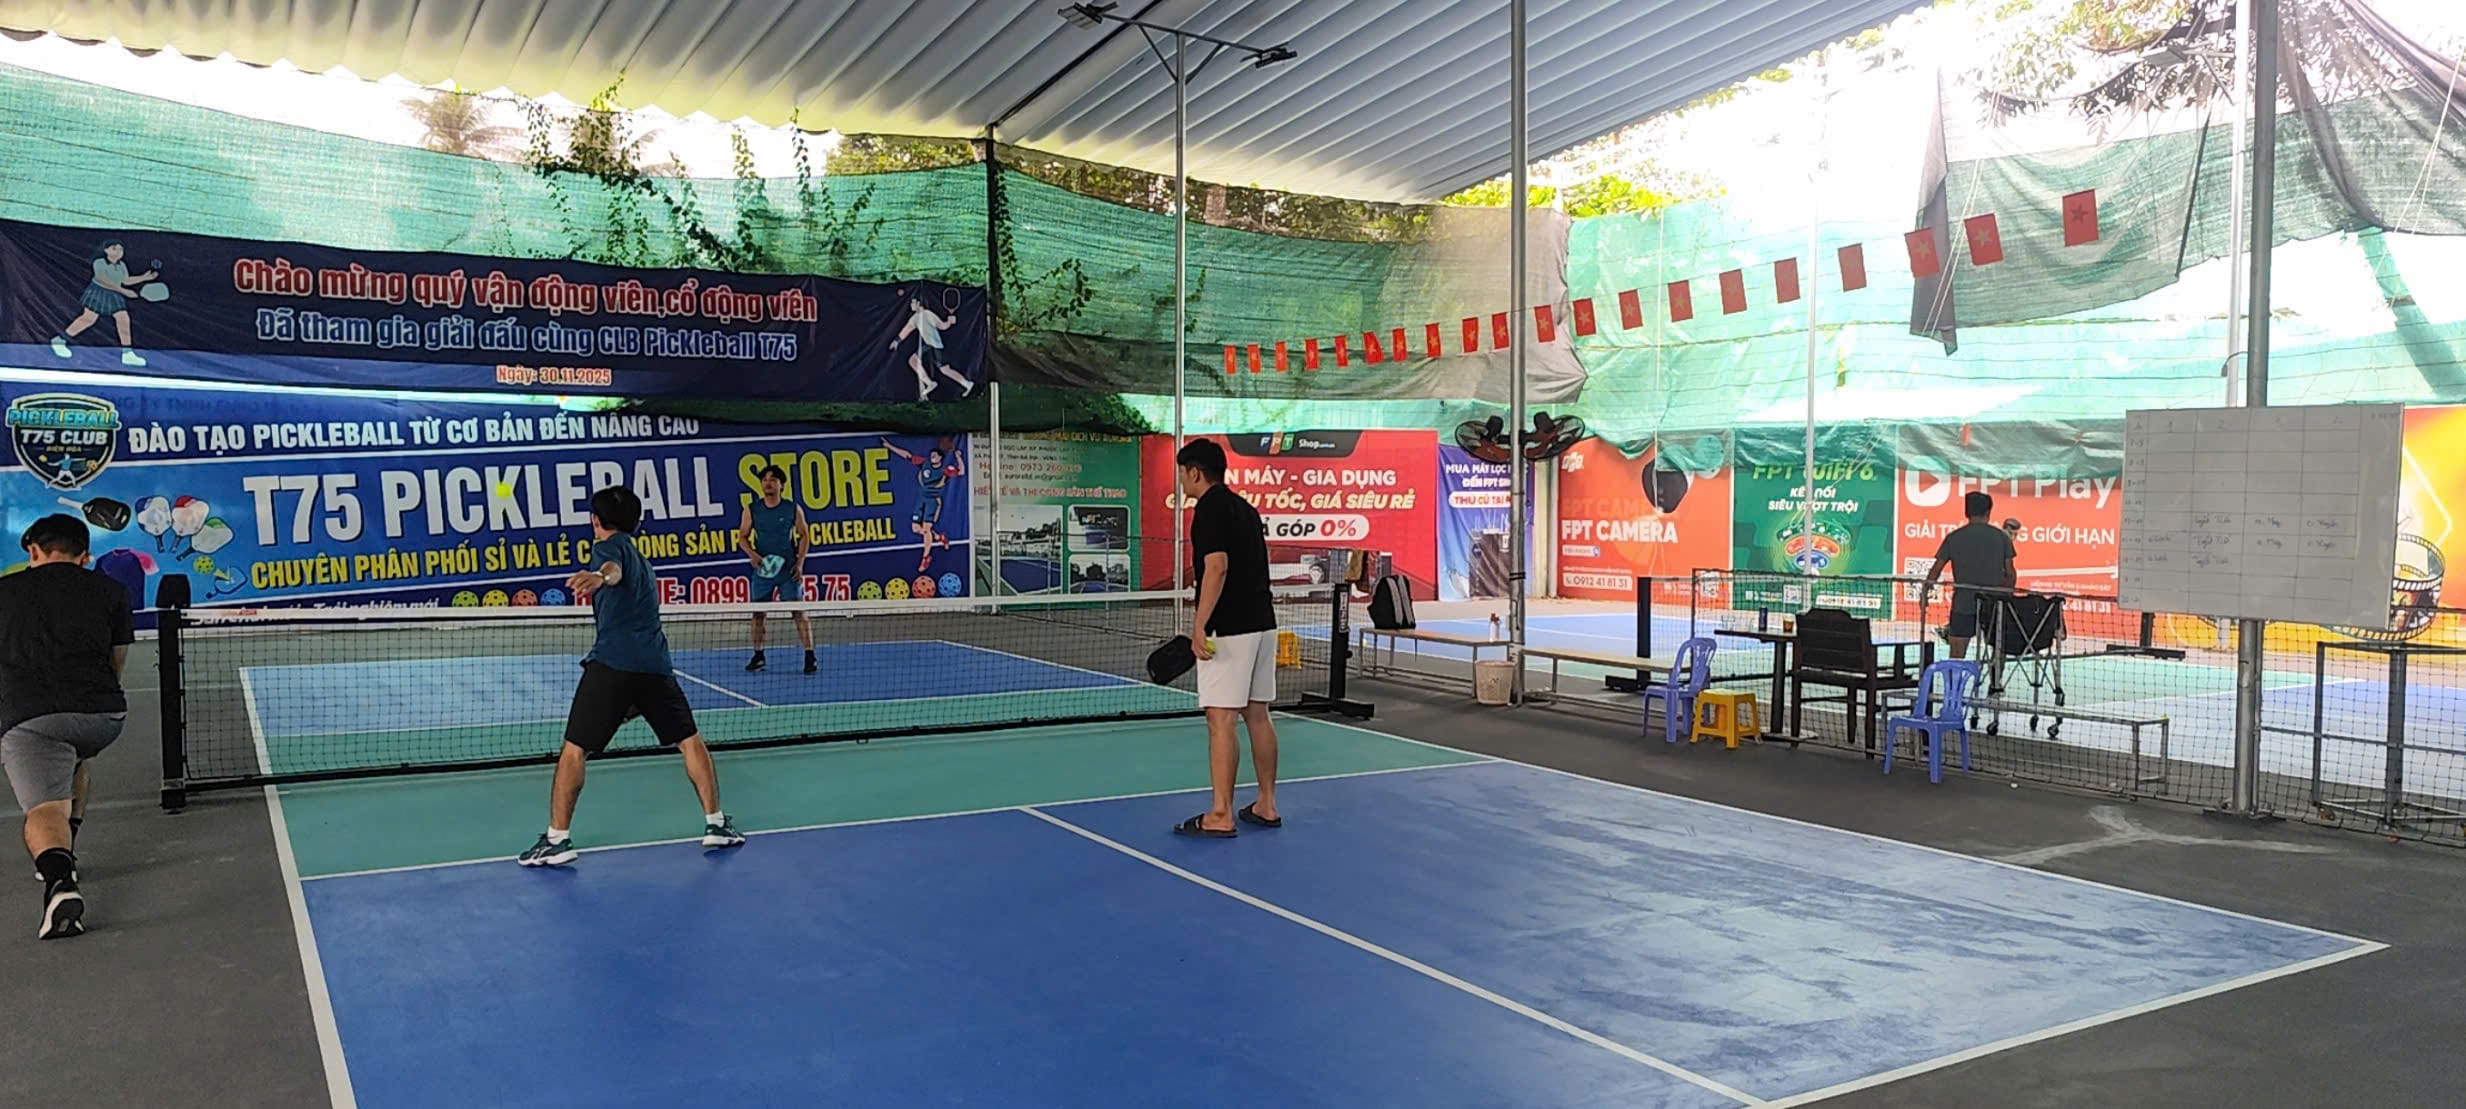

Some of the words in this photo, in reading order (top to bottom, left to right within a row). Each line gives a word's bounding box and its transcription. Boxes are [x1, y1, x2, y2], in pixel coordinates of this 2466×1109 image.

[234, 258, 313, 296] Chào
[319, 263, 407, 305] mừng
[412, 268, 466, 310] quý
[472, 270, 524, 313] vận
[528, 273, 598, 317] động
[701, 285, 763, 324] động
[767, 288, 818, 322] viên
[256, 308, 295, 340] Đã
[299, 311, 372, 344] tham
[377, 315, 420, 349] gia
[424, 315, 475, 350] giải
[478, 315, 528, 351] đấu
[531, 320, 594, 357] cùng
[598, 326, 641, 354] CLB
[644, 327, 756, 360] Pickleball
[759, 333, 798, 361] T75
[496, 364, 538, 385] Ngày:
[539, 367, 612, 386] 30.11.2025
[8, 408, 120, 428] PICKLEBALL
[20, 429, 55, 444] T75
[60, 430, 109, 445] CLUB
[128, 421, 187, 454] ĐÀO
[193, 425, 245, 456] TẠO
[254, 419, 404, 449] PICKLEBALL
[409, 416, 442, 444] TỪ
[446, 417, 478, 443] CƠ
[485, 410, 533, 443] BẢN
[538, 411, 586, 440] ĐẾN
[592, 414, 651, 438] NÂNG
[1261, 434, 1294, 451] FPT
[1244, 465, 1287, 486] MÁY
[1303, 469, 1337, 486] GIA
[1341, 469, 1397, 490] DỤNG
[1445, 464, 1470, 474] MUA
[1752, 464, 1793, 480] FPT
[243, 472, 363, 546] T75
[738, 448, 894, 511] STORE
[1958, 466, 2022, 498] FPT
[2035, 464, 2117, 509] Play
[1264, 487, 1307, 511] TỐC,
[1310, 489, 1343, 509] GIÁ
[1345, 490, 1389, 509] SIÊU
[1389, 488, 1416, 509] RẺ
[1455, 496, 1477, 505] THU
[1768, 498, 1795, 510] SIÊU
[1831, 499, 1859, 514] TRỘI
[1276, 518, 1316, 537] GÓP
[1320, 519, 1357, 537] 0%
[1561, 520, 1593, 541] FPT
[1595, 520, 1679, 544] CAMERA
[1904, 519, 1935, 539] GIẢI
[1939, 520, 1964, 538] TR
[2032, 524, 2071, 544] GIỚI
[2075, 528, 2115, 549] HẠN
[251, 554, 349, 589] CHUYÊN
[354, 549, 421, 581] PHÂN
[424, 540, 480, 577] PHỐI
[485, 537, 507, 572] SỈ
[512, 538, 545, 569] VÀ
[547, 532, 572, 567] LẺ
[685, 523, 726, 557] SẢN
[792, 518, 897, 547] PCKLEBALL
[689, 577, 750, 604] 0899
[821, 575, 851, 603] 75
[1573, 576, 1594, 587] 0912
[1596, 577, 1607, 587] 41
[1608, 578, 1617, 588] 81
[1618, 578, 1628, 588] 31
